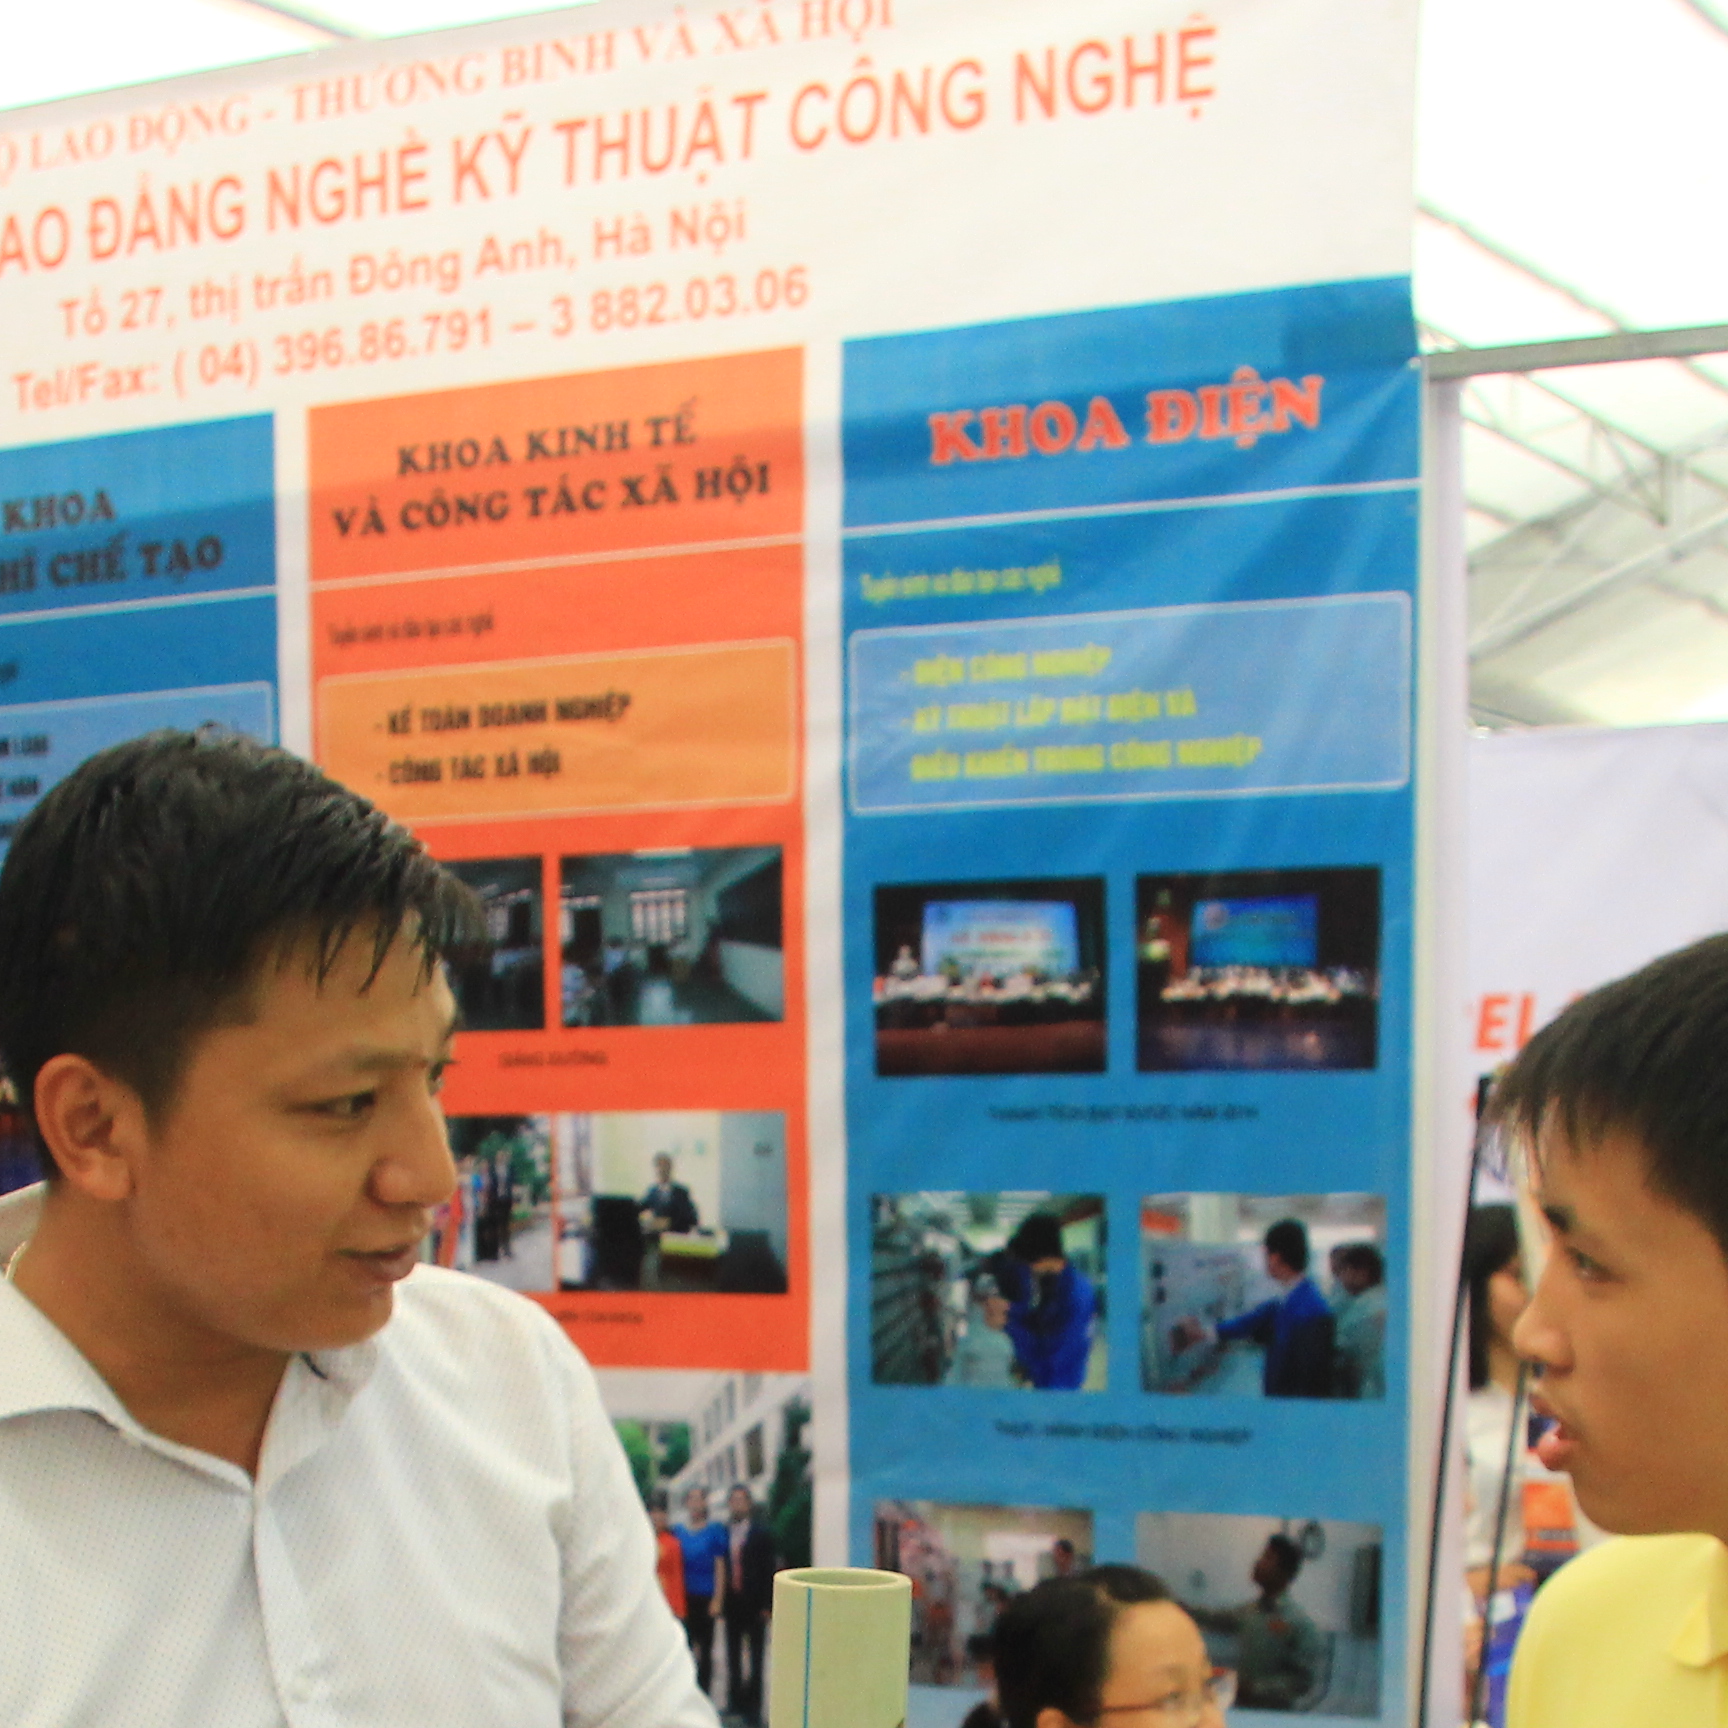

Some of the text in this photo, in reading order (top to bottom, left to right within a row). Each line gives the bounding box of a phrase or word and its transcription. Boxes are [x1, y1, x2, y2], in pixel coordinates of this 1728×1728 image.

[29, 118, 116, 173] LAO
[127, 94, 250, 156] ĐỘNG
[289, 52, 486, 124] THƯƠNG
[631, 6, 697, 63] VÀ
[86, 170, 247, 262] ĐẲNG
[266, 127, 431, 233] NGHỀ
[453, 108, 532, 204] KỸ
[552, 86, 769, 188] THUẬT
[789, 55, 987, 152] CÔNG
[1014, 13, 1217, 122] NGHỆ
[59, 197, 747, 340] Tổ 27, thị trấn Đông Anh, Hà Nội
[11, 361, 162, 414] Tel/Fax:
[273, 305, 492, 377] 396.86.791
[550, 295, 575, 338] 3
[589, 264, 810, 333] 882.03.06
[397, 395, 699, 477] KHOA KINH TẾ
[928, 364, 1326, 466] KHOA ĐIỆN
[1, 487, 117, 535] KHOA
[333, 453, 772, 538] VÀ CÔNG TÁC XÃ HỘI
[48, 529, 130, 588] CHẾ
[139, 534, 224, 584] TẠO
